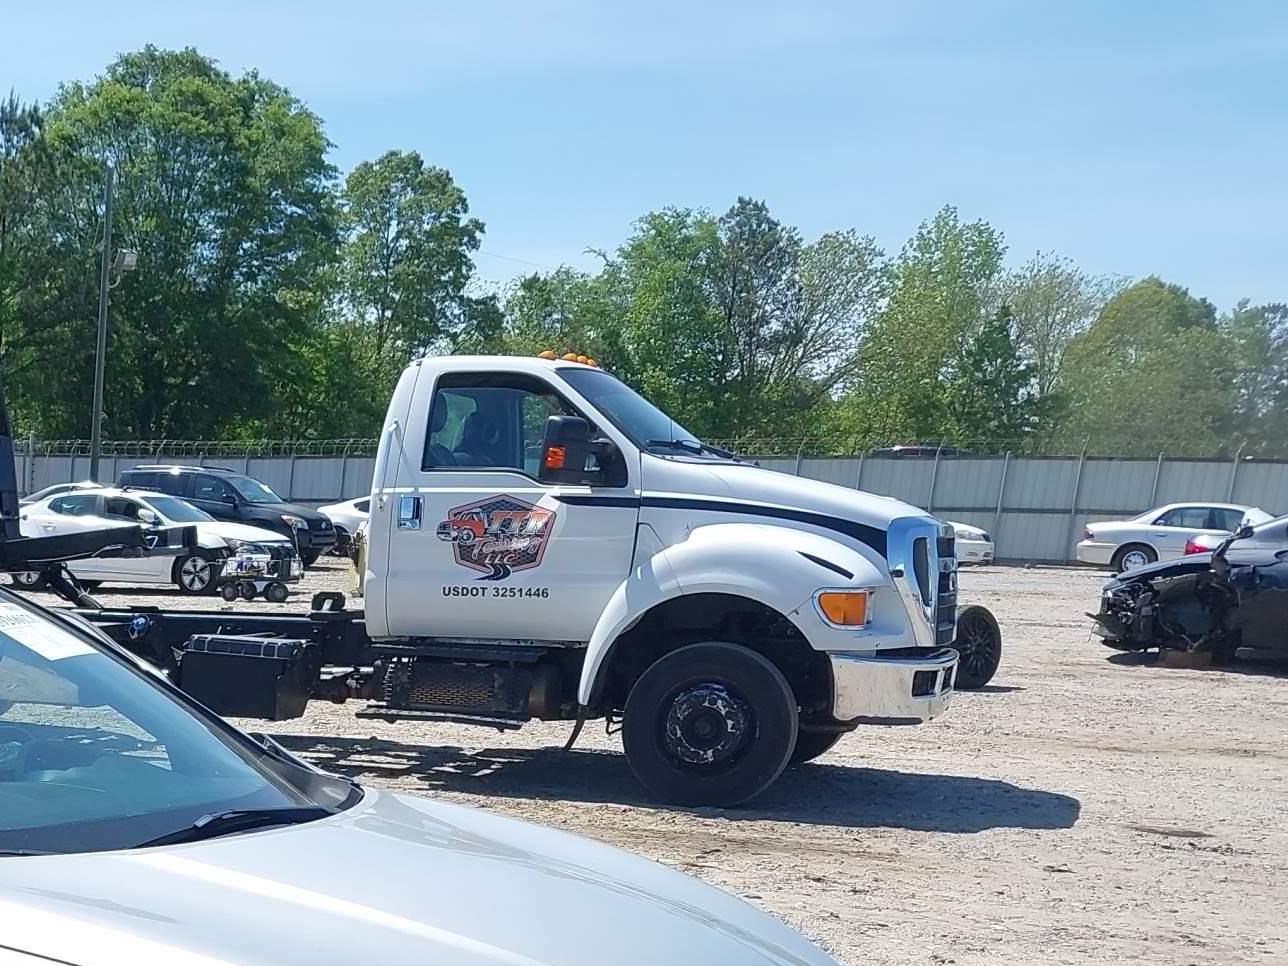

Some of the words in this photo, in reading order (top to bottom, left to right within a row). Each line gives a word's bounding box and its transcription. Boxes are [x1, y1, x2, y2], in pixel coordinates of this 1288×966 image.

[471, 536, 544, 560] Towing
[484, 552, 517, 564] LLC
[442, 586, 488, 597] USDOT
[492, 587, 550, 599] 3251446
